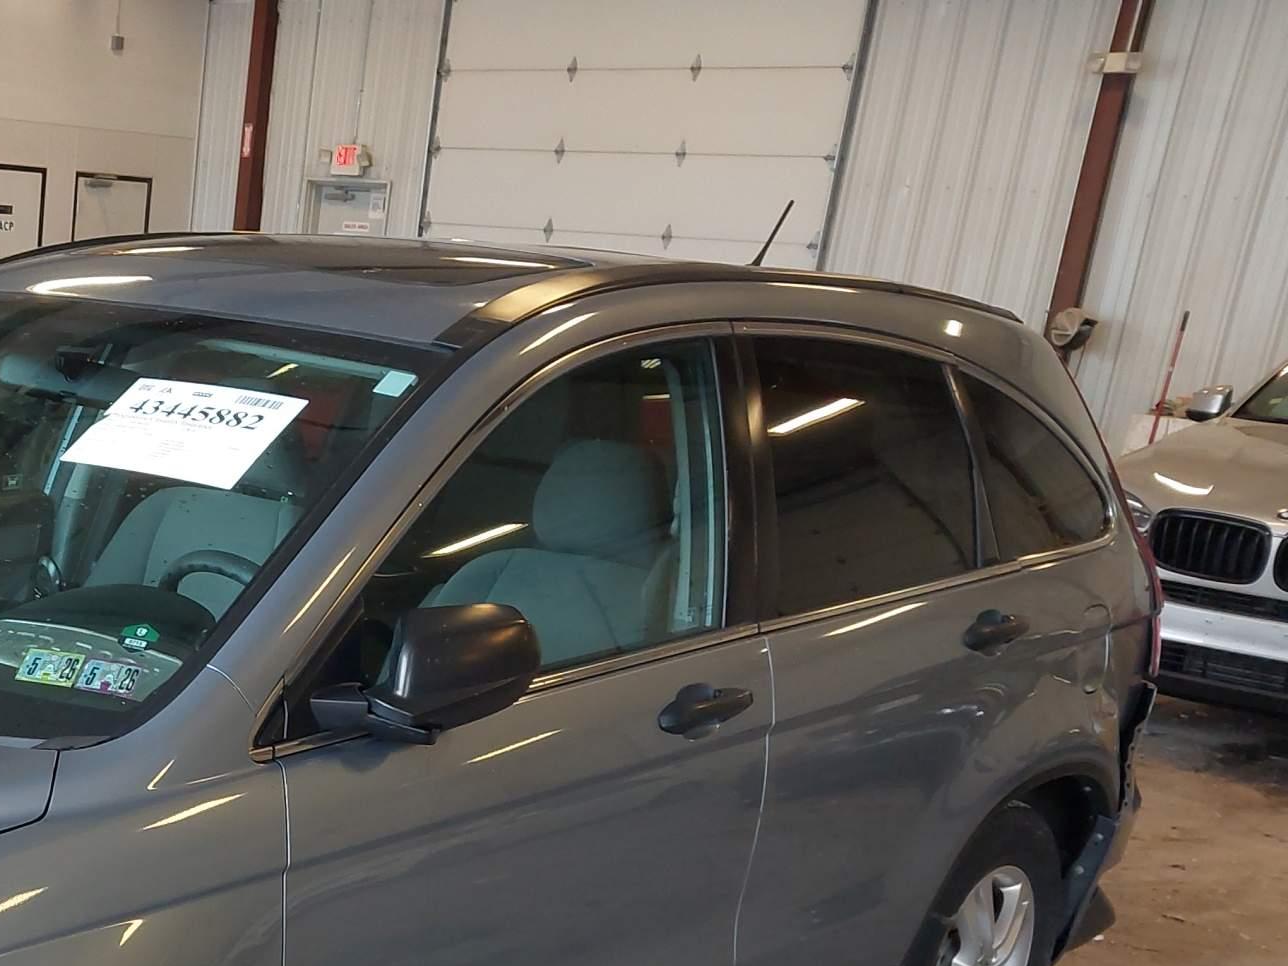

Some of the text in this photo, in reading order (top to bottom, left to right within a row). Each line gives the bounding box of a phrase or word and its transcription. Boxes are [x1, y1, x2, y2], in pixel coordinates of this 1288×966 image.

[129, 398, 265, 431] 43445882
[27, 657, 80, 681] 5 26
[85, 666, 140, 692] 5 26
